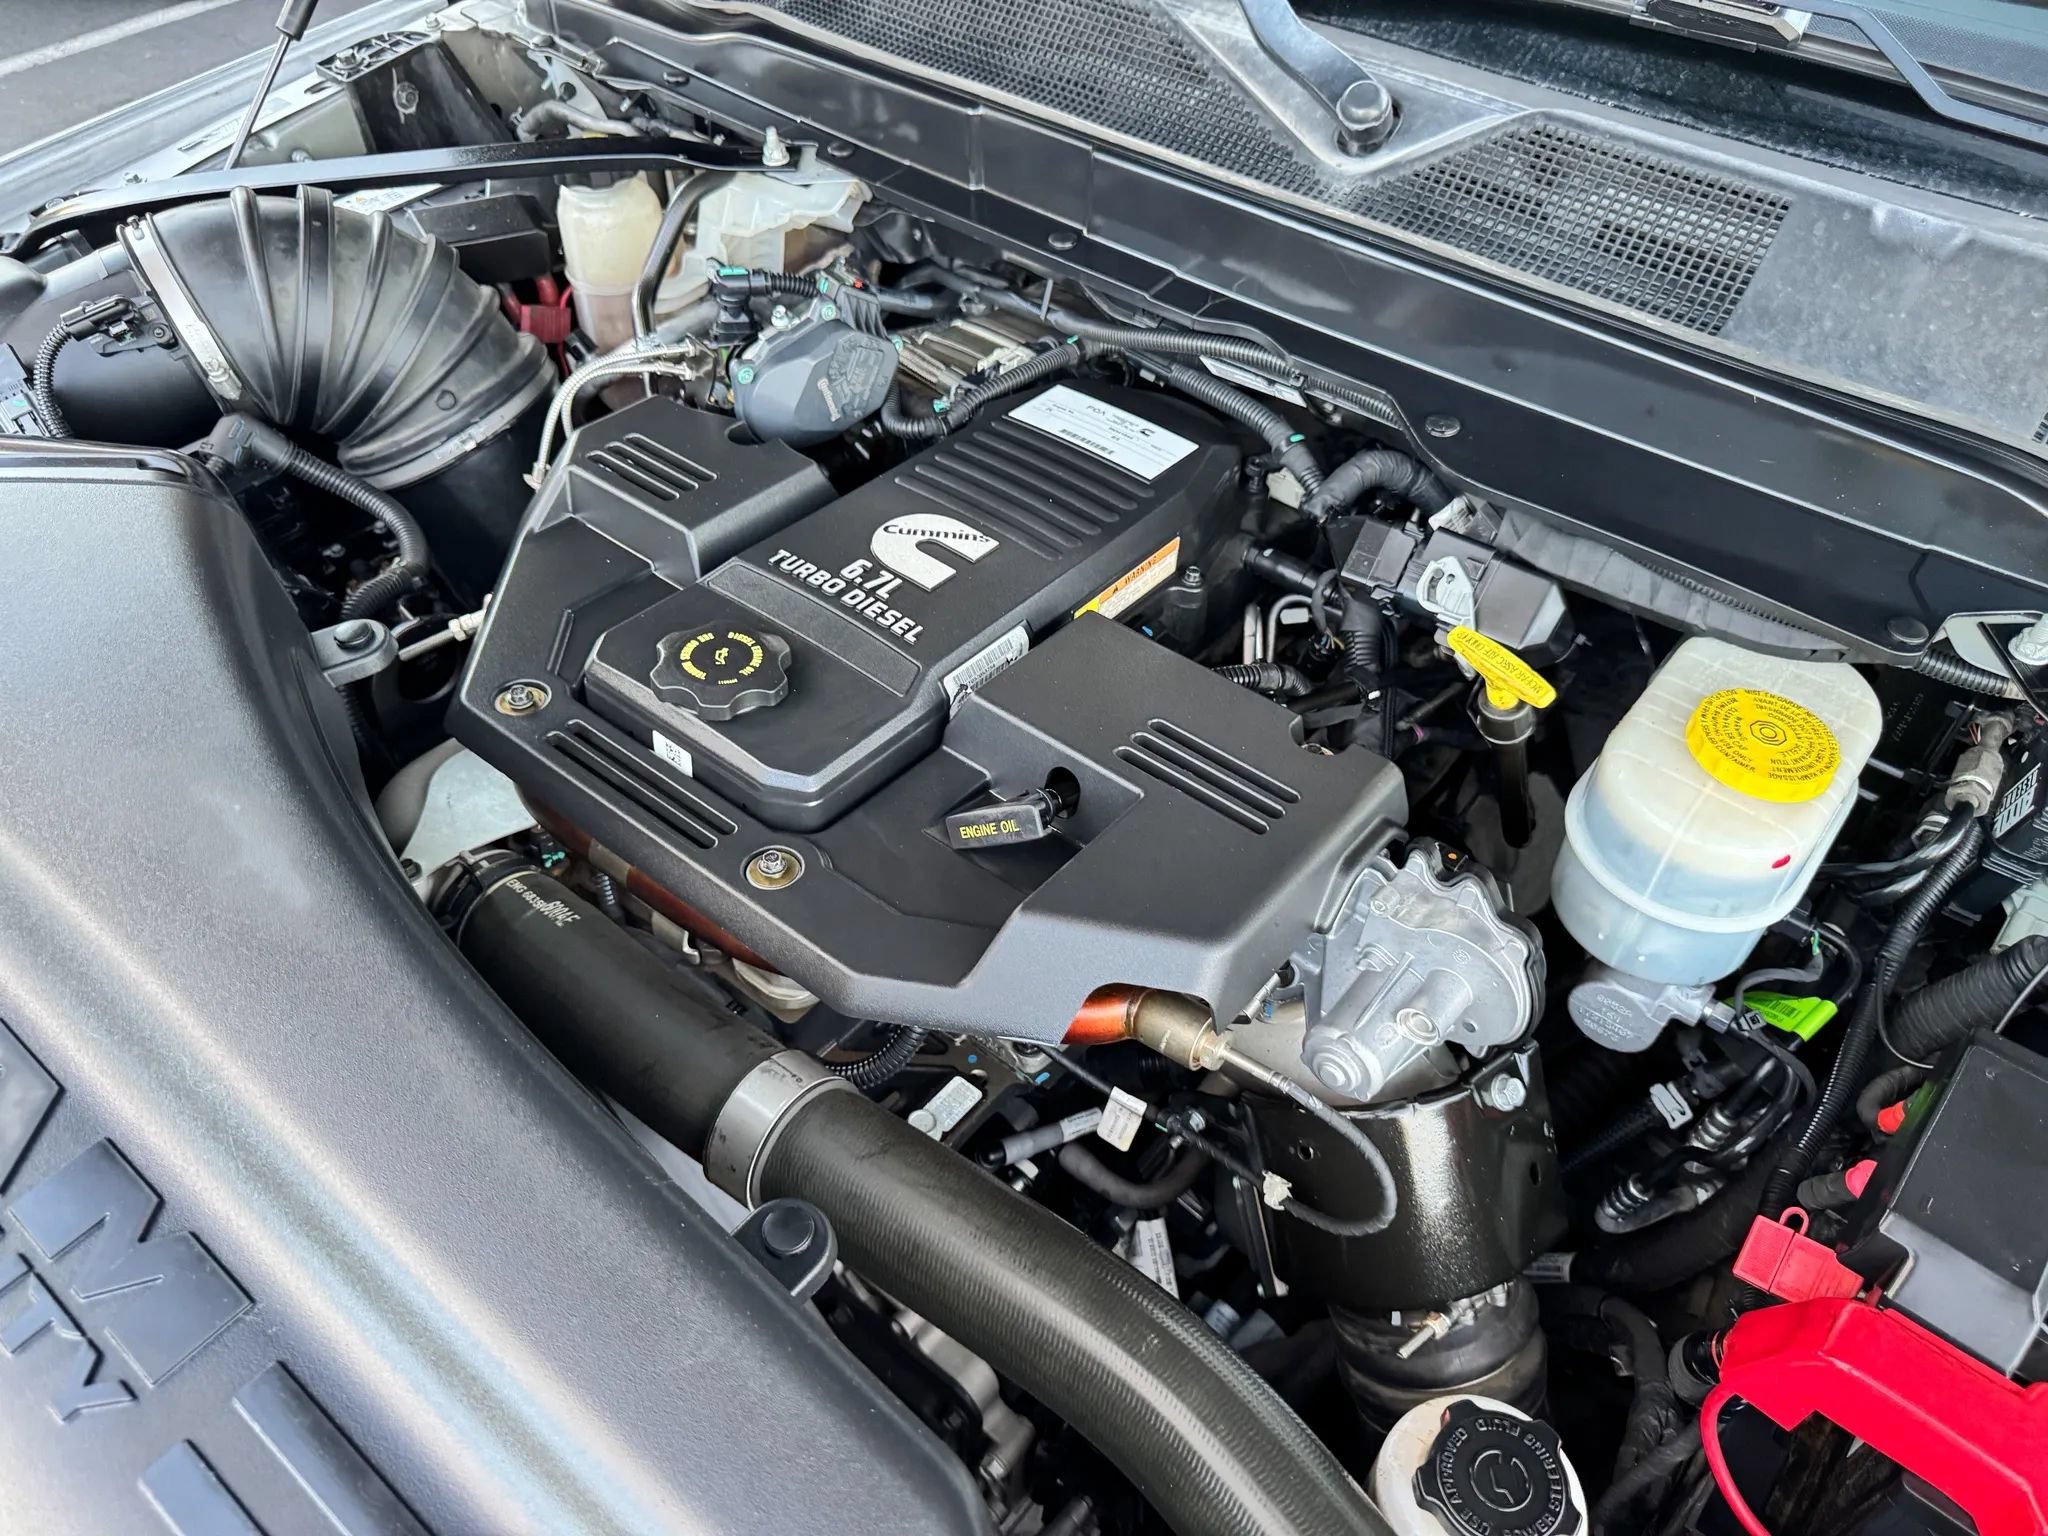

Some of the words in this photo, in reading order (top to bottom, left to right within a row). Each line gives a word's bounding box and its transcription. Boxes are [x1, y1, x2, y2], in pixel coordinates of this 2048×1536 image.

[883, 524, 991, 543] Cummins
[839, 558, 903, 601] 6.7L
[768, 548, 847, 596] TURBO
[840, 589, 924, 645] DIESEL
[738, 665, 756, 677] OIL
[959, 822, 998, 839] ENGINE
[1000, 819, 1020, 833] OIL
[506, 878, 528, 893] ENG
[1475, 1418, 1521, 1438] FLUID
[1442, 1427, 1468, 1505] APPROVED
[1523, 1433, 1563, 1512] STEERING
[1461, 1508, 1491, 1536] USE
